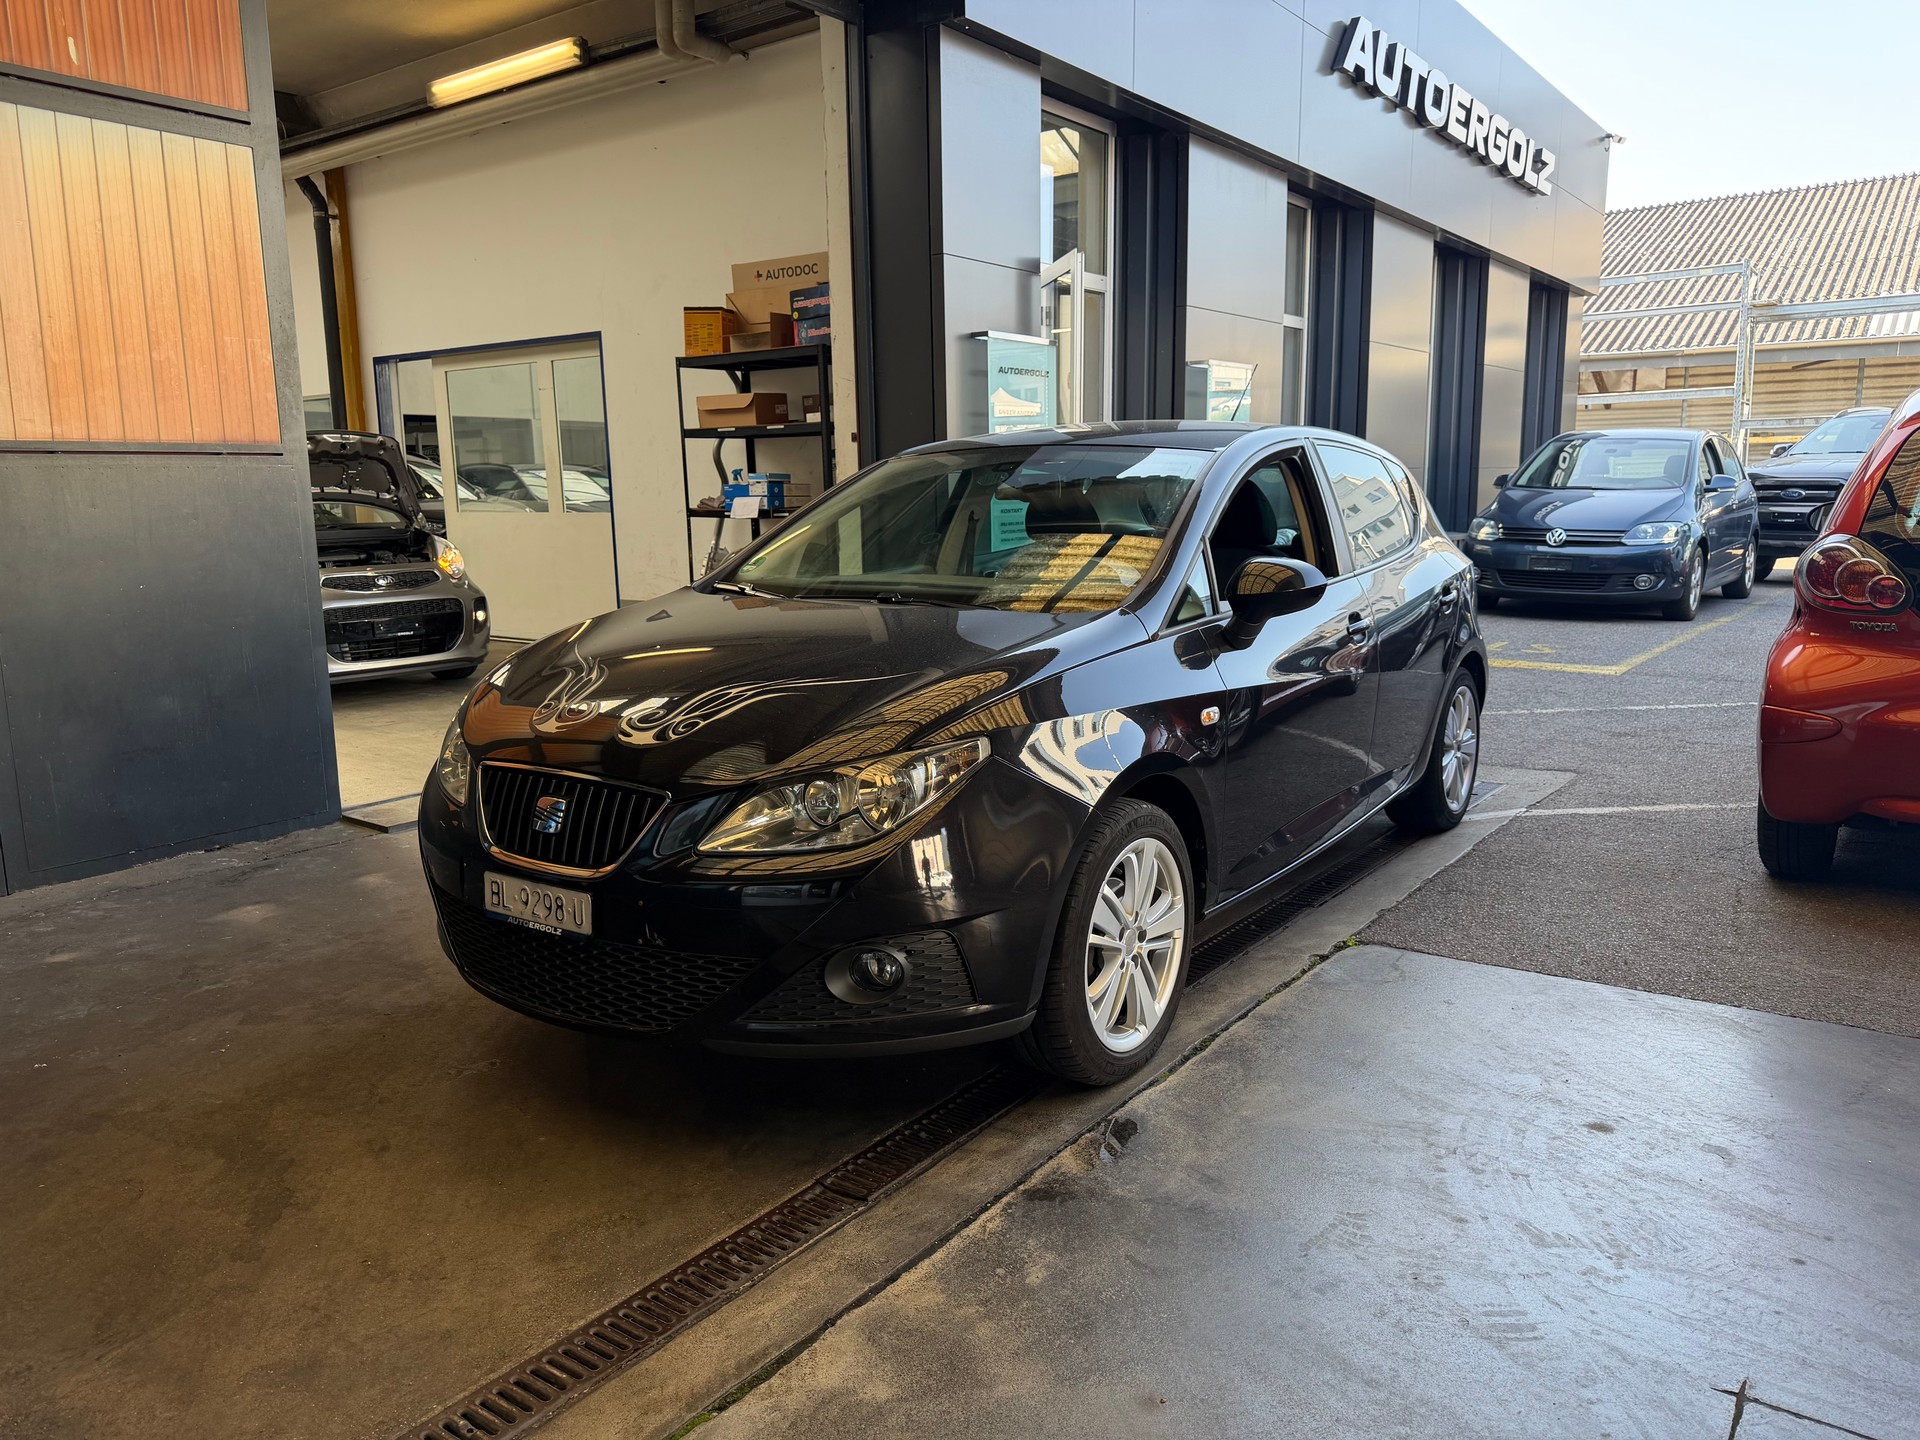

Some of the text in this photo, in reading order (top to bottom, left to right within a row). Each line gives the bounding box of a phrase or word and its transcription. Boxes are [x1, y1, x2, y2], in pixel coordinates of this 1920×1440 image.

[1335, 15, 1556, 196] AUTOERGOLZ
[765, 262, 819, 281] AUTODOC
[998, 366, 1050, 378] AUTOERGOLZ
[1849, 620, 1898, 633] TOYOTA
[490, 878, 586, 928] BL 9298 U
[507, 916, 562, 936] AUTOERGOLZ
